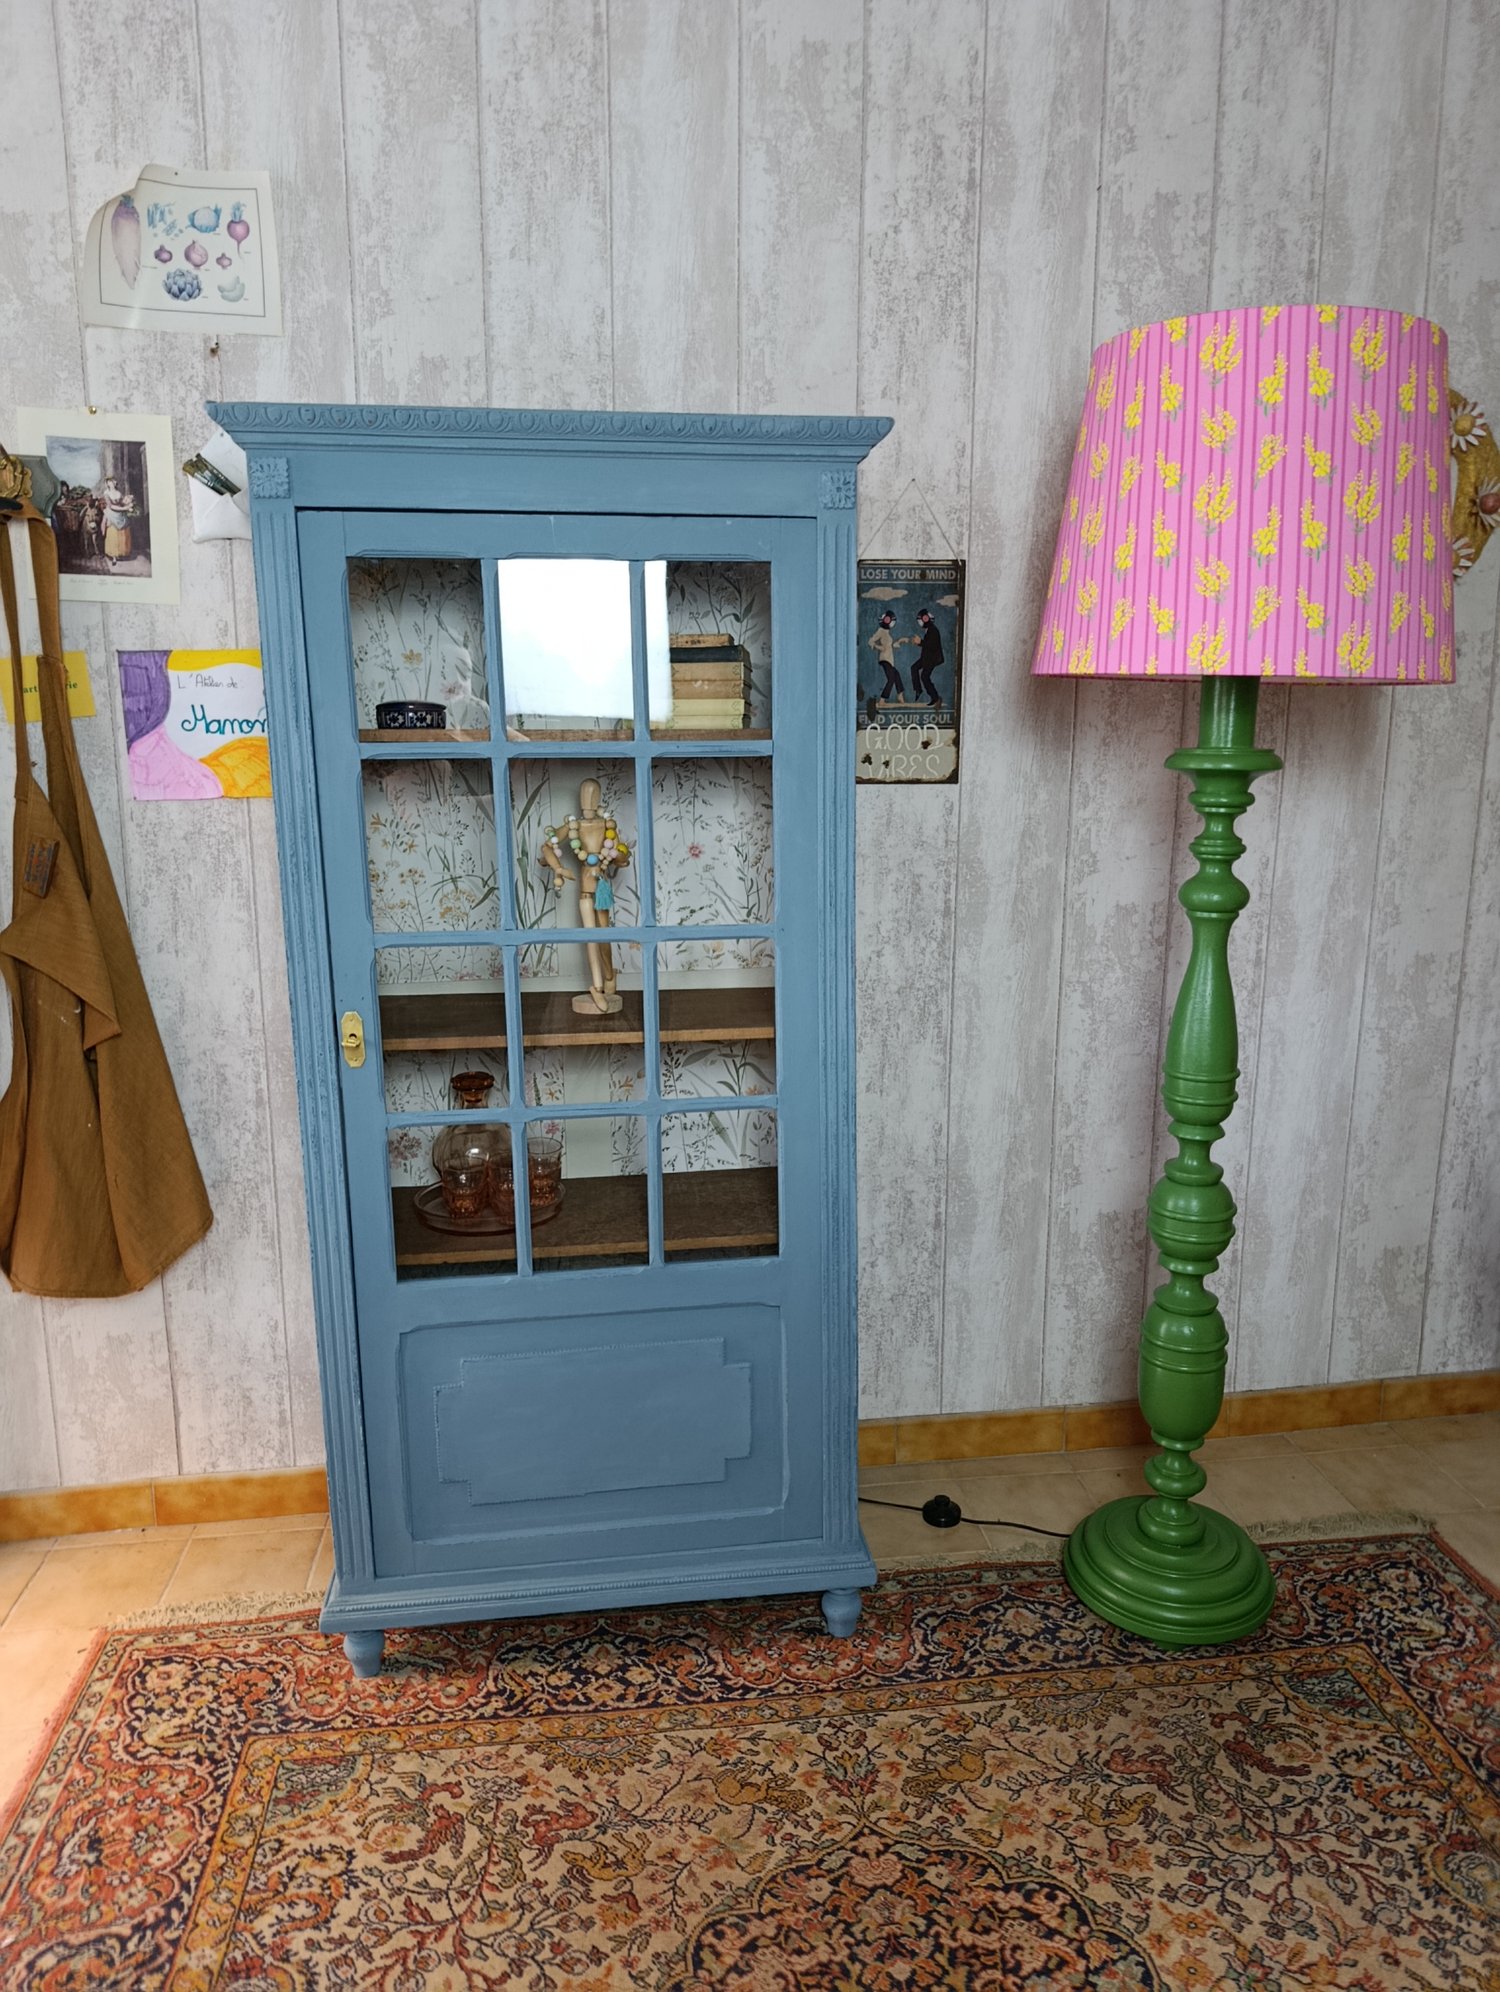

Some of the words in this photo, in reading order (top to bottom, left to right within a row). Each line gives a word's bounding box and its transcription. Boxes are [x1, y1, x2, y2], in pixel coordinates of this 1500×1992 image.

[861, 568, 888, 580] LOSE
[891, 569, 921, 580] YOUR
[926, 569, 956, 580] MIND
[858, 715, 885, 725] FID
[889, 714, 921, 724] YOUR
[923, 714, 953, 724] SOUL
[866, 723, 944, 751] GOOD
